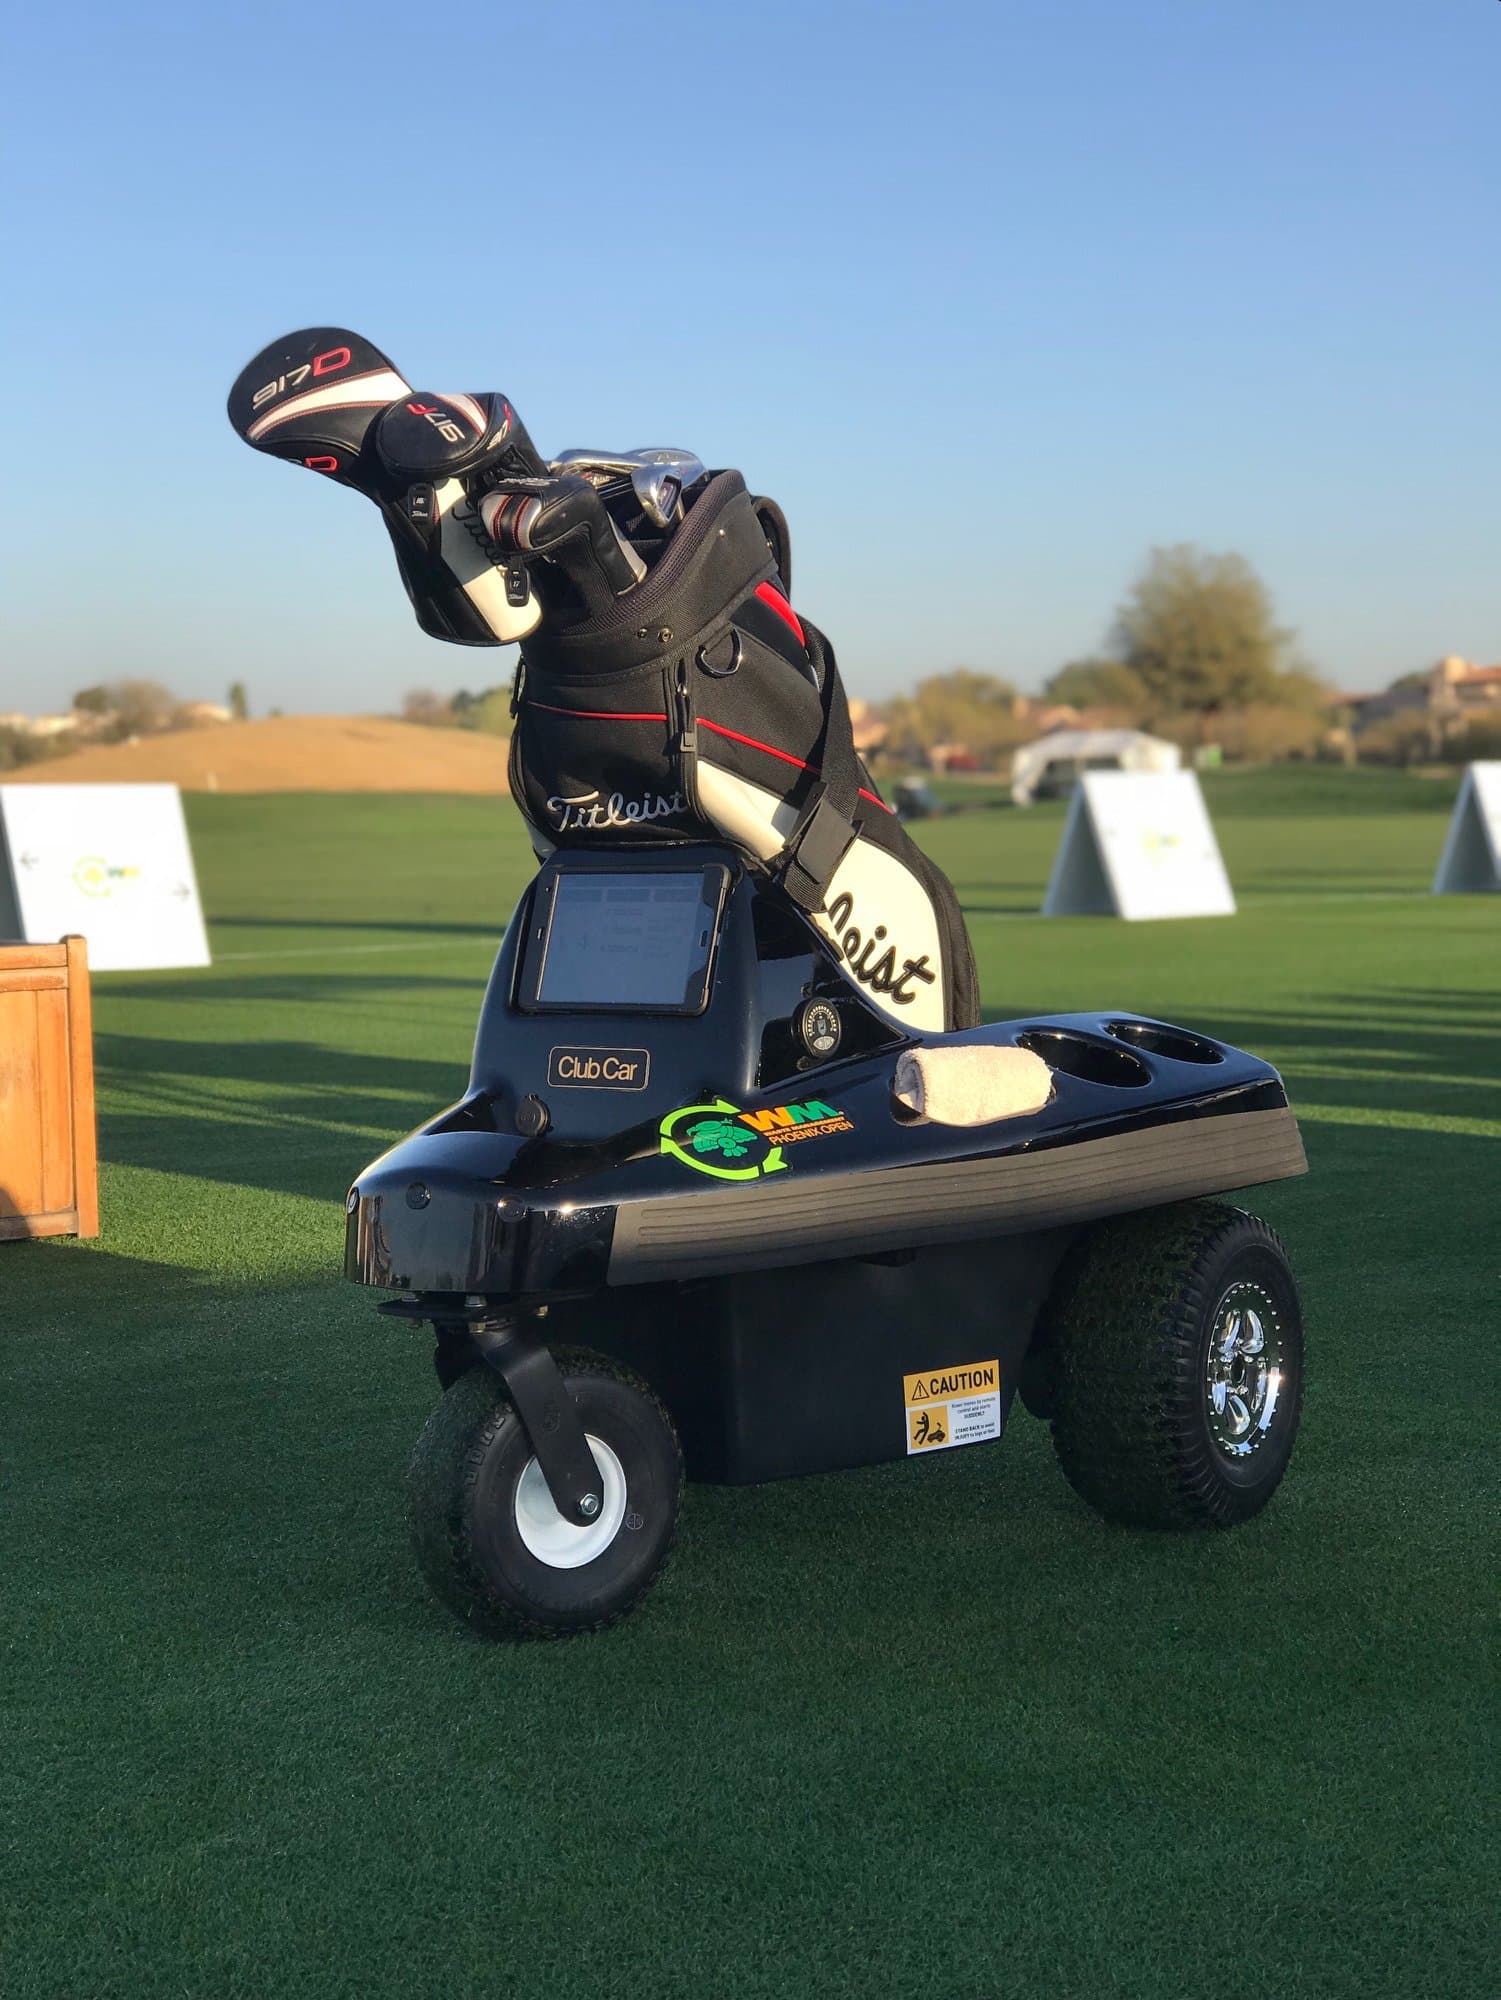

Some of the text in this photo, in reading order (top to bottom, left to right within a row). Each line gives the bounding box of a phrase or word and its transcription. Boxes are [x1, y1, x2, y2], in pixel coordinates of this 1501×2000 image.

[252, 347, 351, 410] 917D
[547, 790, 688, 833] Titleist
[558, 1055, 638, 1081] Club Car
[738, 1100, 840, 1131] WM
[768, 1120, 855, 1145] PHOENIX OPEN
[930, 1368, 994, 1395] CAUTION
